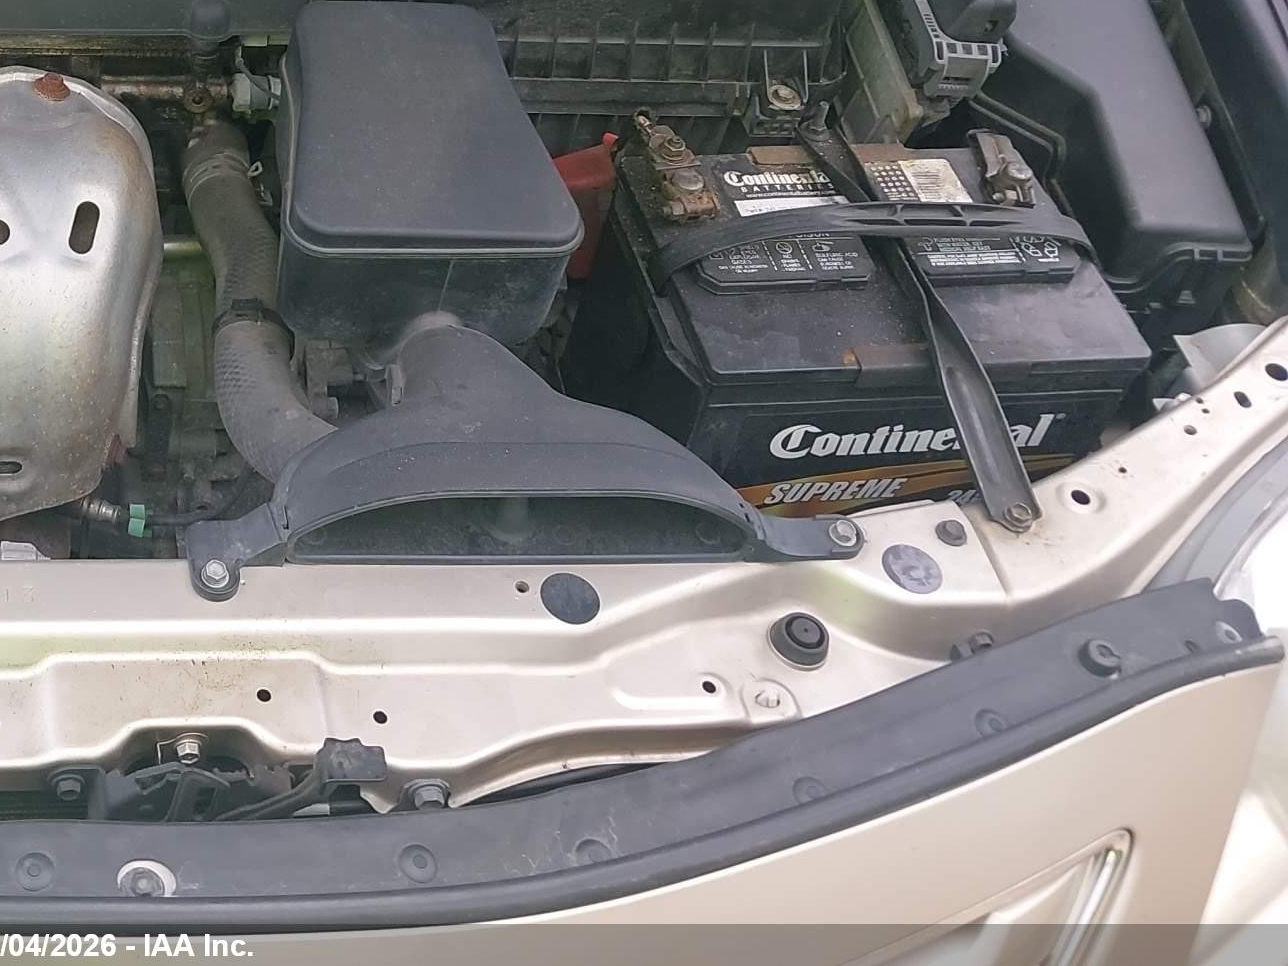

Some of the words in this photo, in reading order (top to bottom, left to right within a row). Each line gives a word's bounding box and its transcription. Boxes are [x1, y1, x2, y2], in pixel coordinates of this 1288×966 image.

[740, 182, 835, 194] BATTERIES
[769, 414, 1055, 460] Contineal
[764, 478, 908, 504] SUPREME
